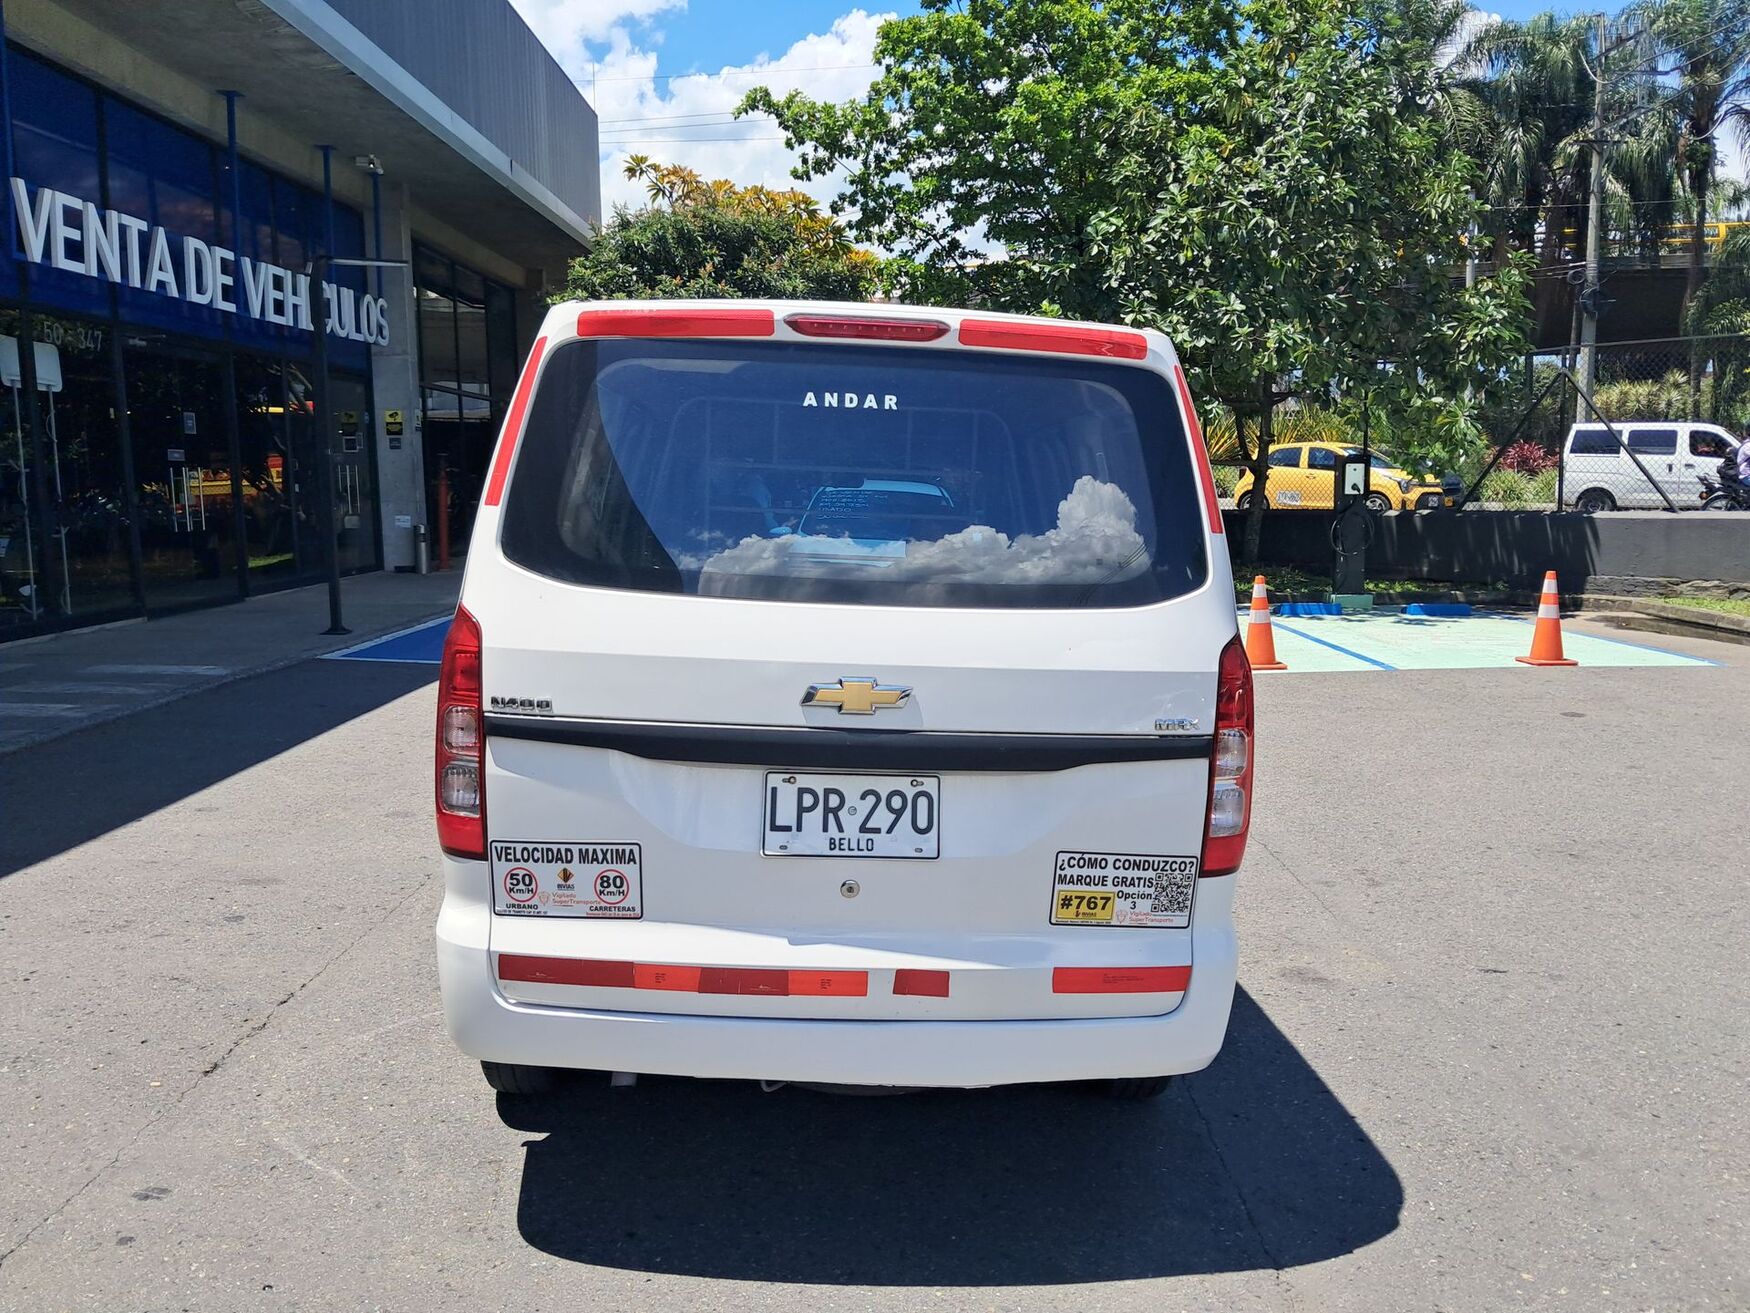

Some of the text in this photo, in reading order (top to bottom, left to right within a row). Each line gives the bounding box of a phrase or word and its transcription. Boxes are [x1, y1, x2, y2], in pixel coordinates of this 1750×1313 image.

[10, 177, 179, 298] VENTA
[183, 236, 237, 313] DE
[803, 391, 898, 410] ANDAR
[769, 786, 934, 835] LPR 290
[828, 837, 875, 852] BELLO
[494, 845, 637, 865] VELOCIDAD MAXIMA
[1058, 853, 1195, 873] ¿CÓMO CONDUZCO?
[508, 873, 534, 887] 50
[599, 875, 625, 889] 80
[1057, 873, 1154, 889] MARQUE GRATIS
[508, 887, 534, 895] Km/H
[598, 889, 625, 897] Km/H
[1117, 890, 1152, 901] Opción
[1060, 895, 1112, 911] #767
[1130, 901, 1137, 910] 3
